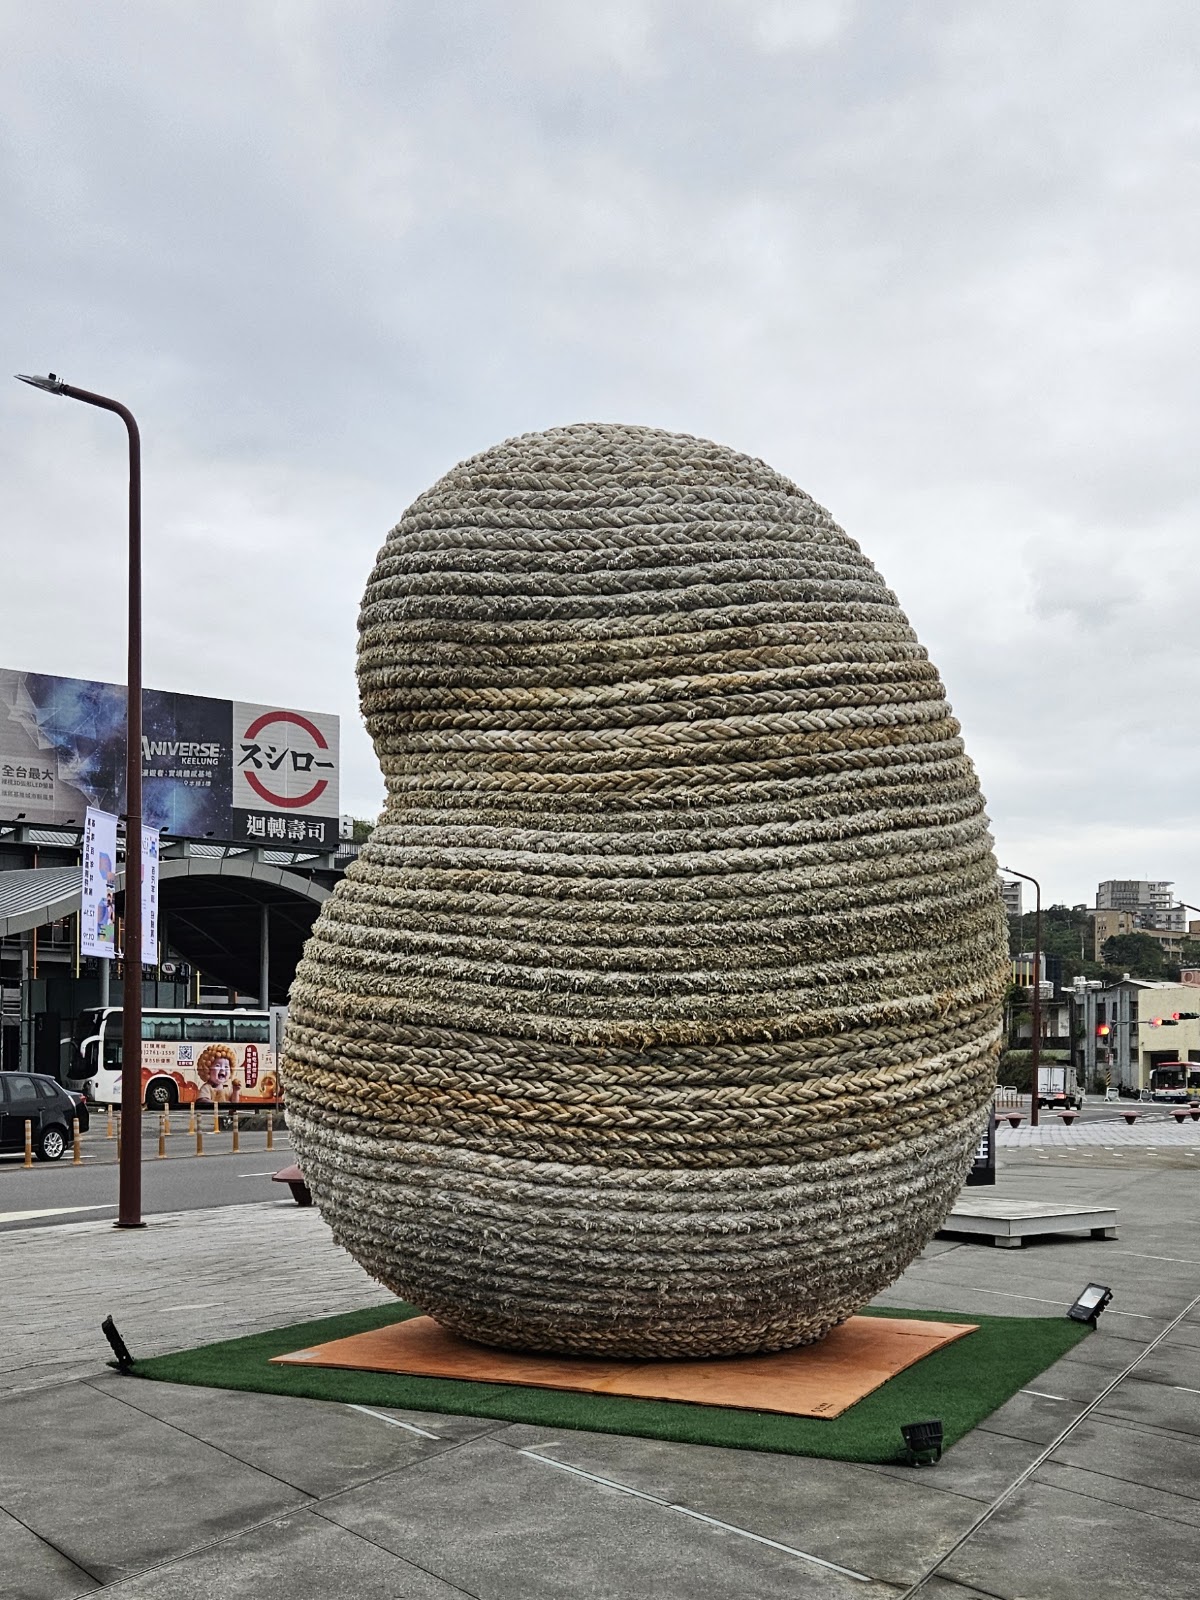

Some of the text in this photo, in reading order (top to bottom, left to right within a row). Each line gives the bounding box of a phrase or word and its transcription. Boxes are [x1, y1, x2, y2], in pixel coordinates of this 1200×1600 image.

[182, 757, 219, 765] KEELUNG
[237, 744, 334, 772] スシロー
[2, 765, 54, 781] 全台最大
